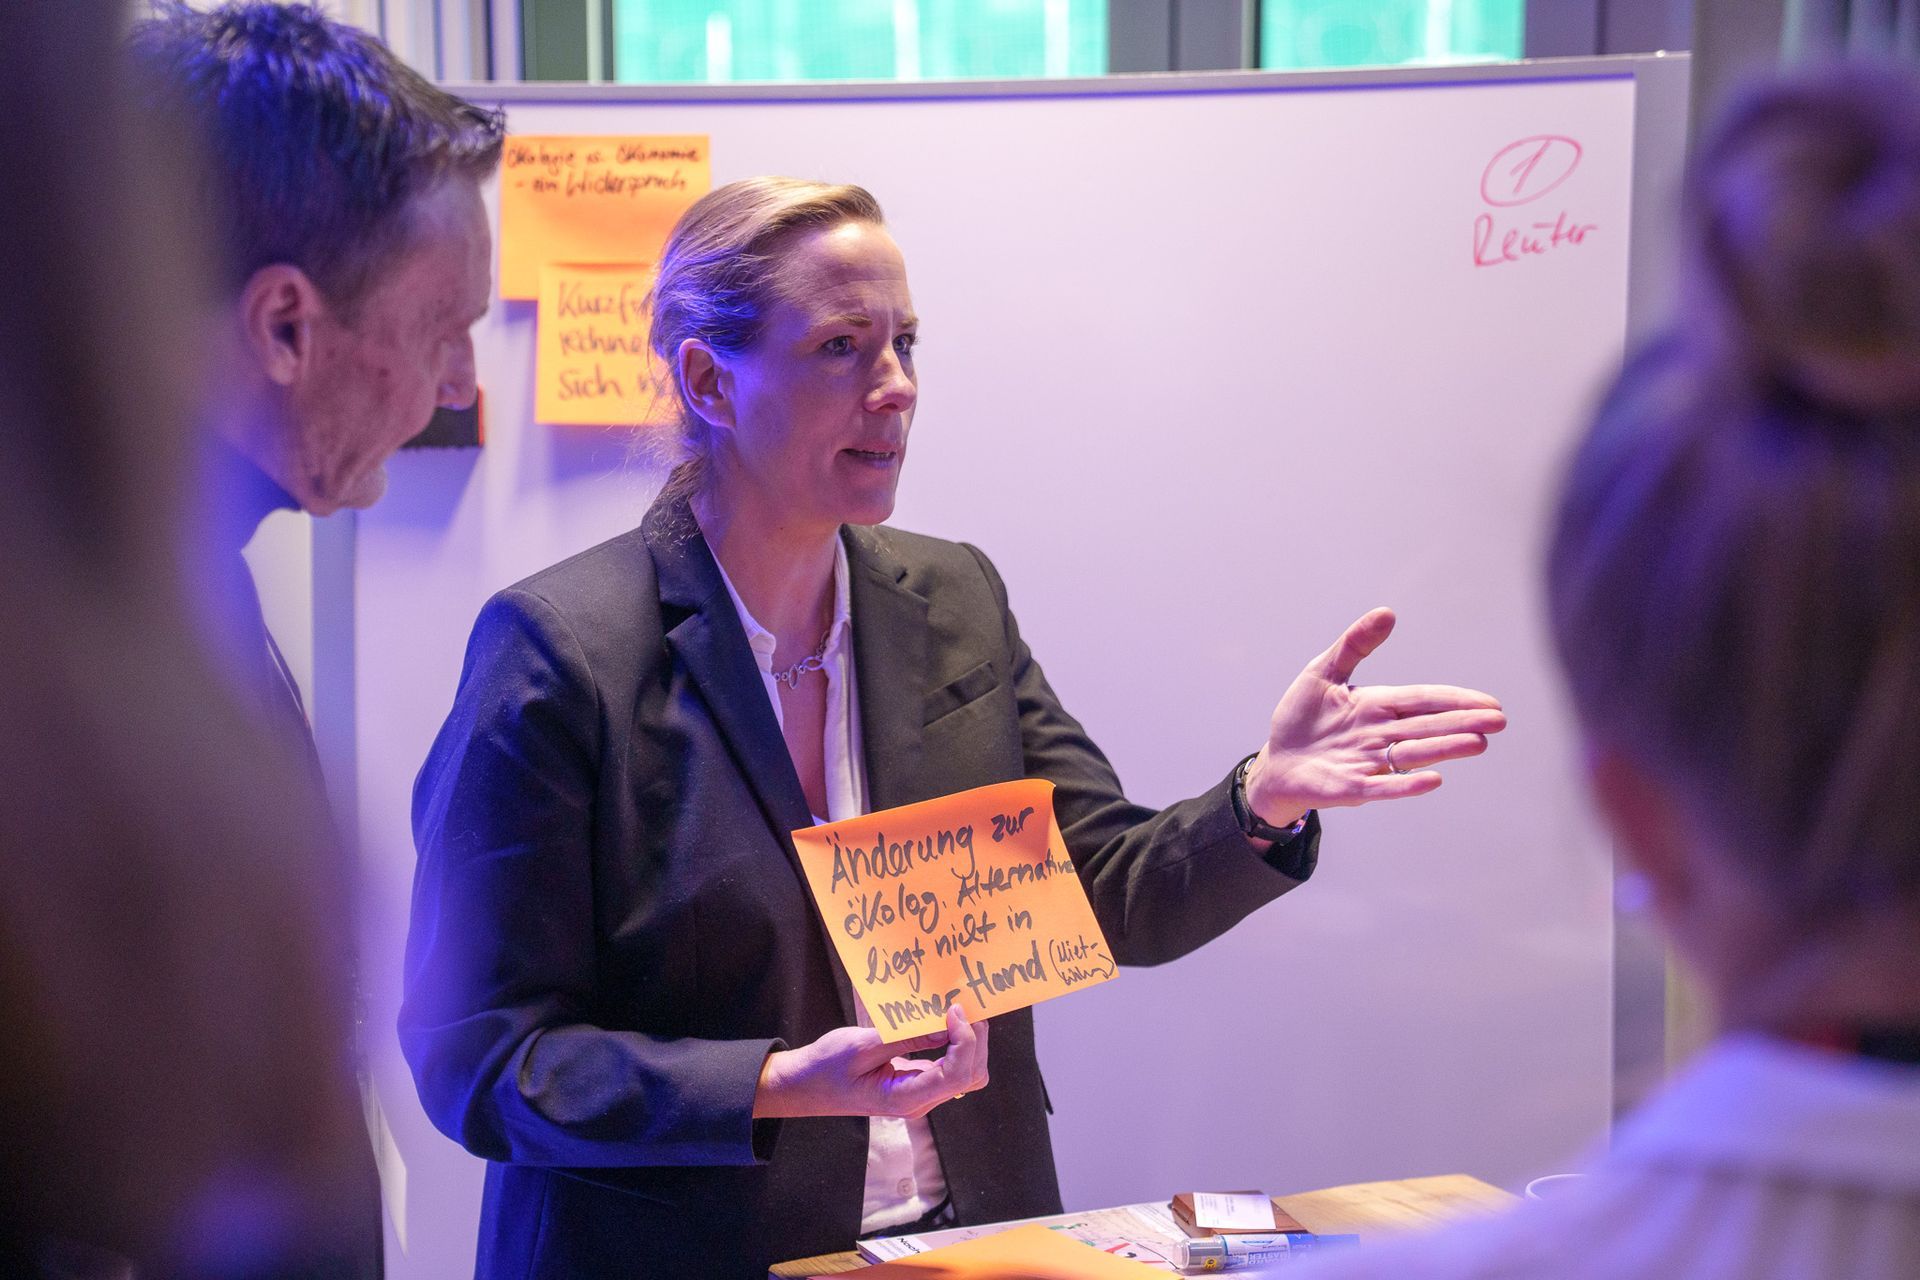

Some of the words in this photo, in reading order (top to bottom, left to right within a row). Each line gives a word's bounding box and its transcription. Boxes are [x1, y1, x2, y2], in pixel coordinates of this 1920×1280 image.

[825, 824, 975, 894] Änderung
[991, 806, 1035, 843] zur
[865, 937, 926, 993] liegt
[934, 910, 997, 959] nicht
[1007, 905, 1033, 933] in
[877, 988, 961, 1030] meiner
[960, 939, 1047, 1009] Hand
